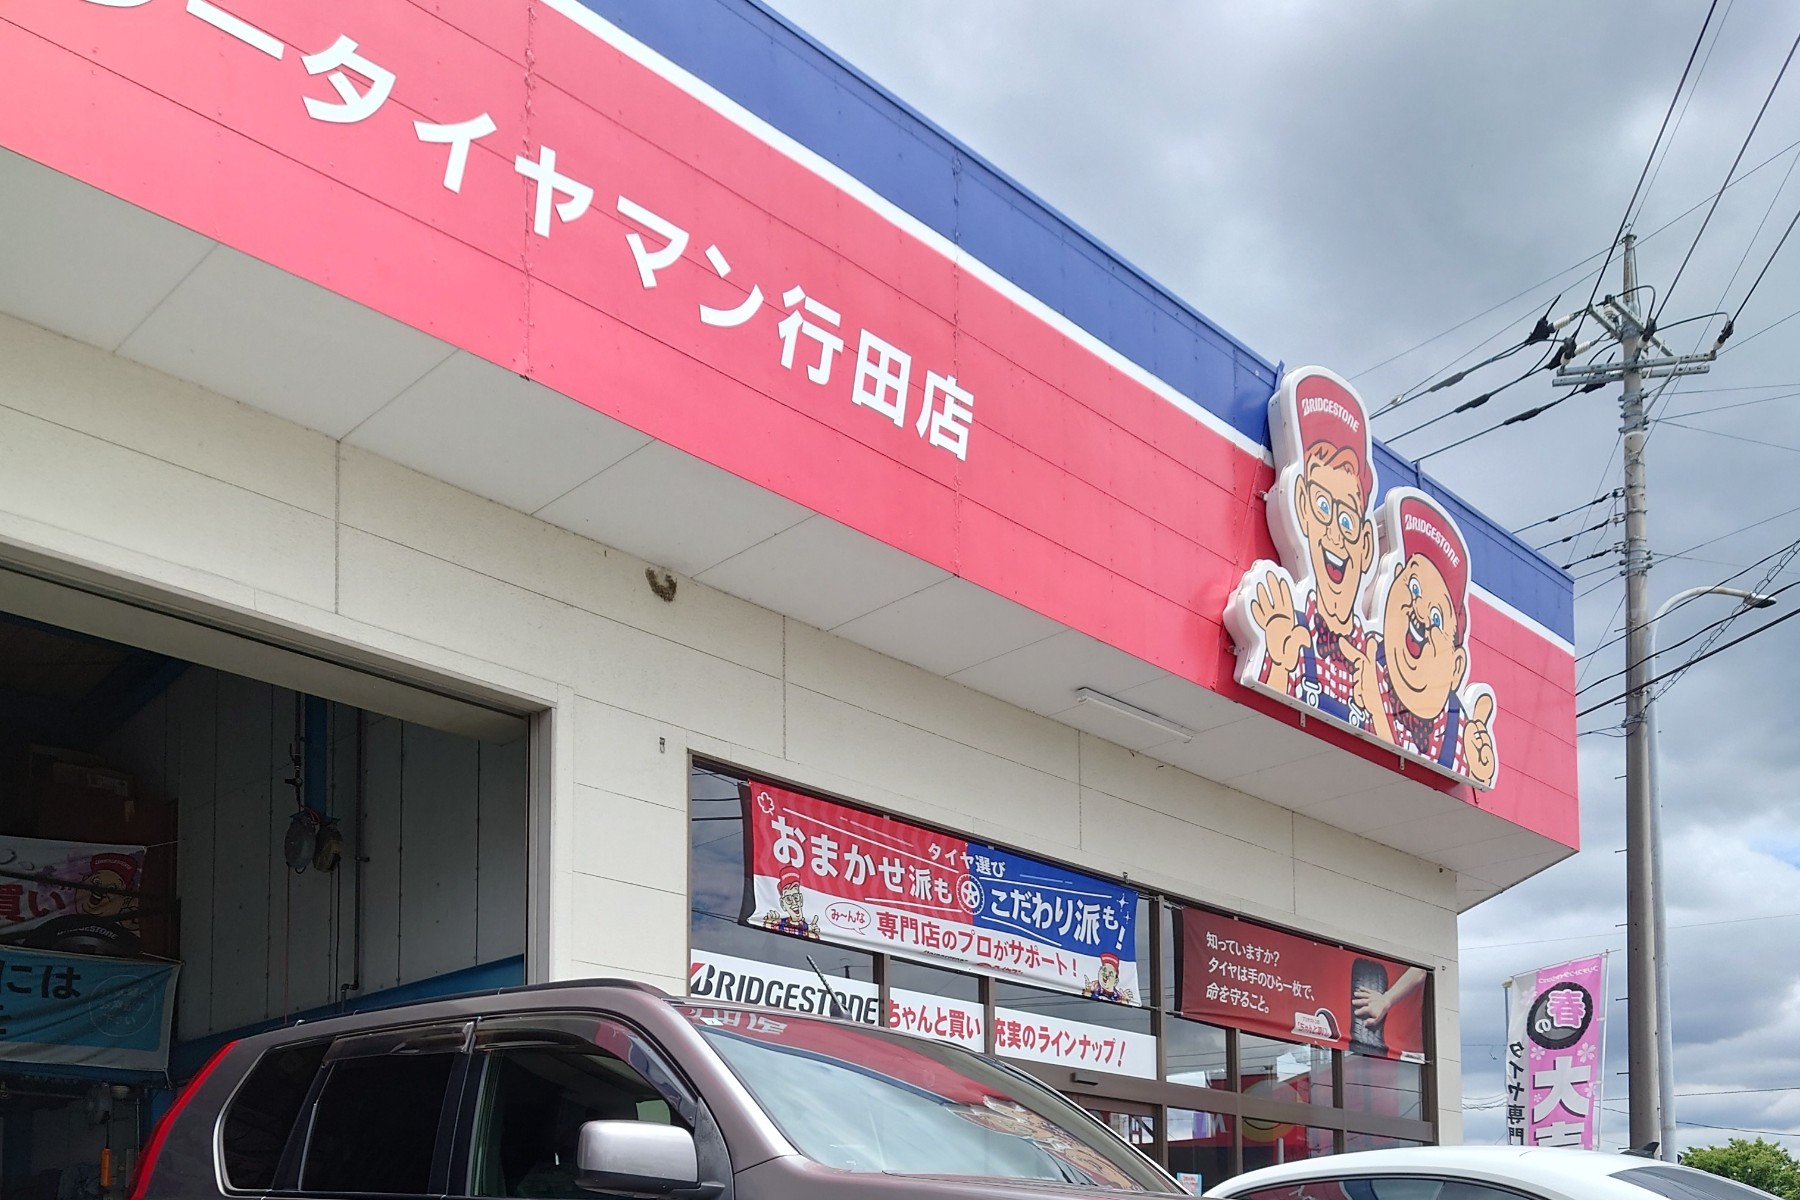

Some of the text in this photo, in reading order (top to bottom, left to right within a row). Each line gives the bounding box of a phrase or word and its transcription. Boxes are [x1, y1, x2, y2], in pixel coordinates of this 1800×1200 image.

[78, 0, 975, 462] ータイヤマン行田店
[1302, 396, 1360, 433] BRIDGESTONE
[1404, 514, 1461, 568] BRIDGESTONE
[770, 815, 953, 904] おまかせ派も
[928, 841, 1006, 878] タイヤ選び
[876, 910, 1078, 978] 専門店のプロがサポート！
[1206, 931, 1280, 967] 知っていますか？
[1206, 982, 1270, 1014] 命を守ること。
[1208, 957, 1315, 1001] タイヤは手のひら一枚で、
[890, 1000, 981, 1040] ちゃんと買い
